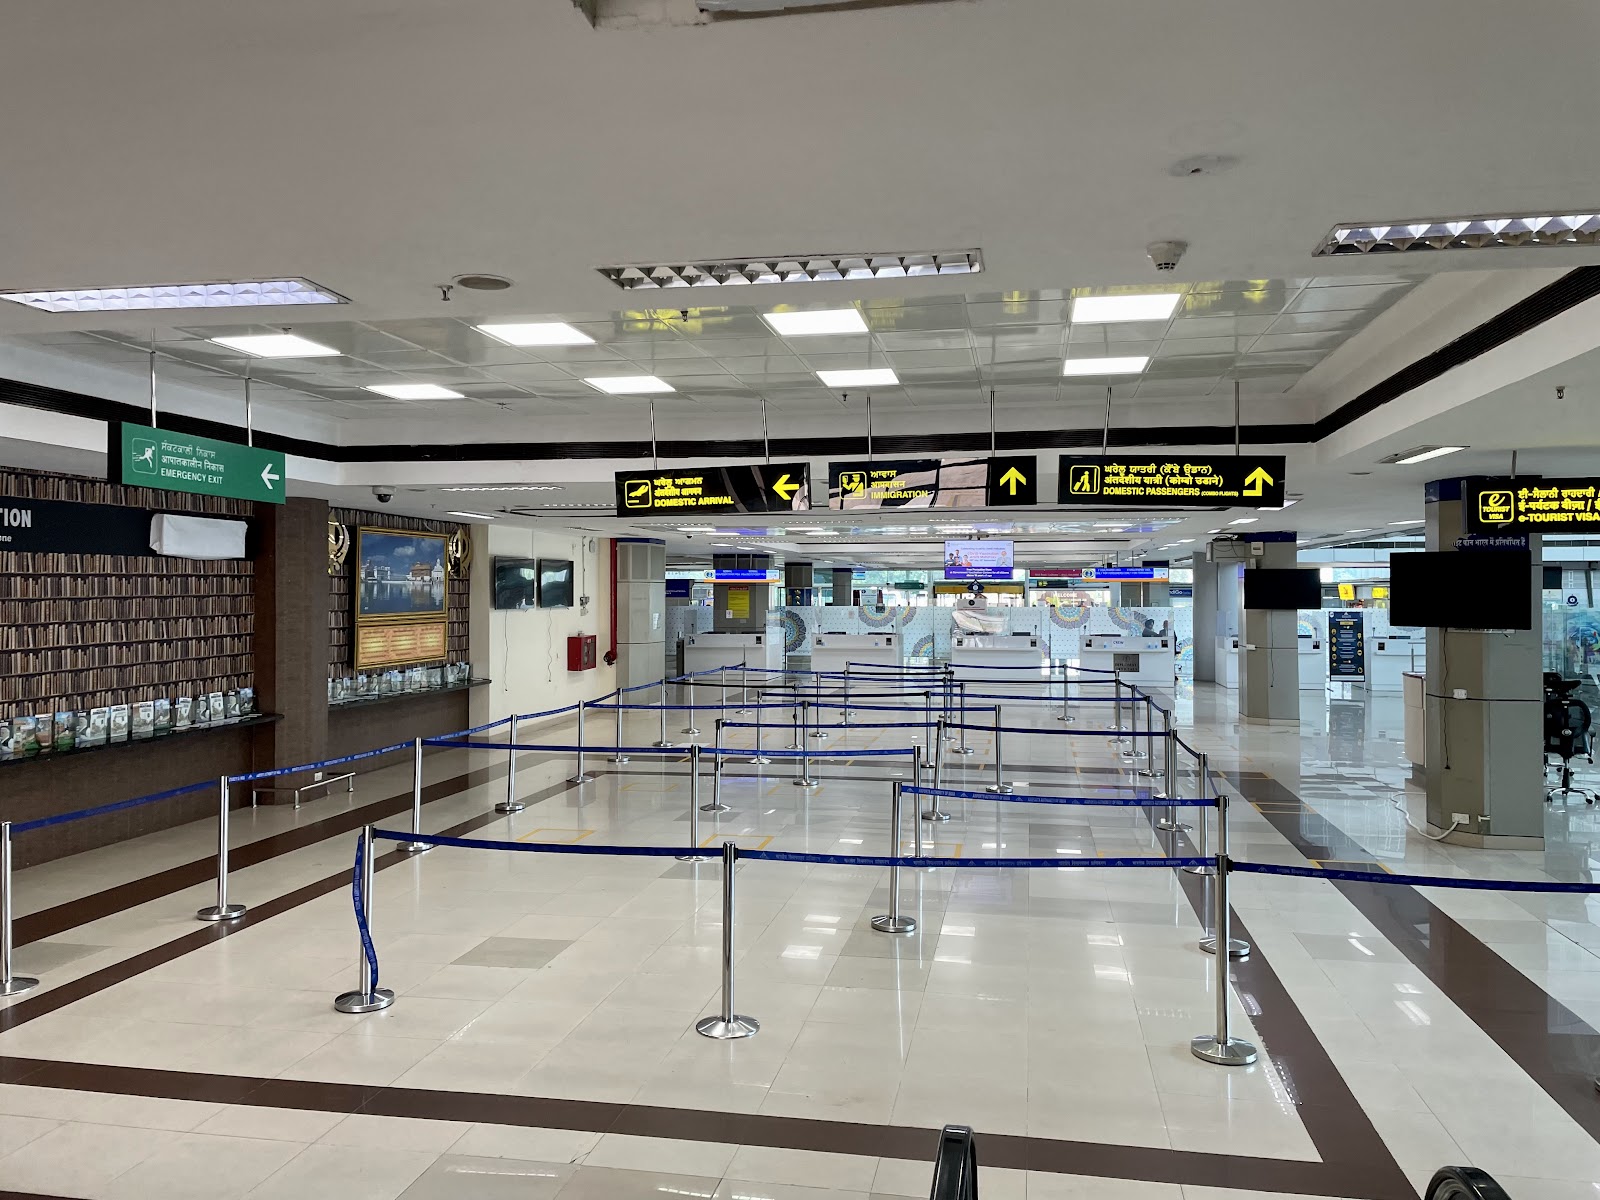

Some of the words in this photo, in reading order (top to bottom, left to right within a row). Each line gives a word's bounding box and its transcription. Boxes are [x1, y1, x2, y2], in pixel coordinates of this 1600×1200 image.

[161, 455, 202, 469] आपातकालीन
[204, 460, 224, 472] निकास
[161, 468, 206, 482] EMERGENCY
[208, 475, 223, 484] EXIT
[1143, 474, 1163, 484] यात्री
[871, 490, 928, 499] IMMIGRATION
[1103, 487, 1144, 495] DOMESTIC
[654, 498, 696, 507] DOMESTIC
[698, 496, 734, 505] ARRIVAL
[1518, 513, 1574, 522] e-TOURIST
[1575, 512, 1600, 521] VISA
